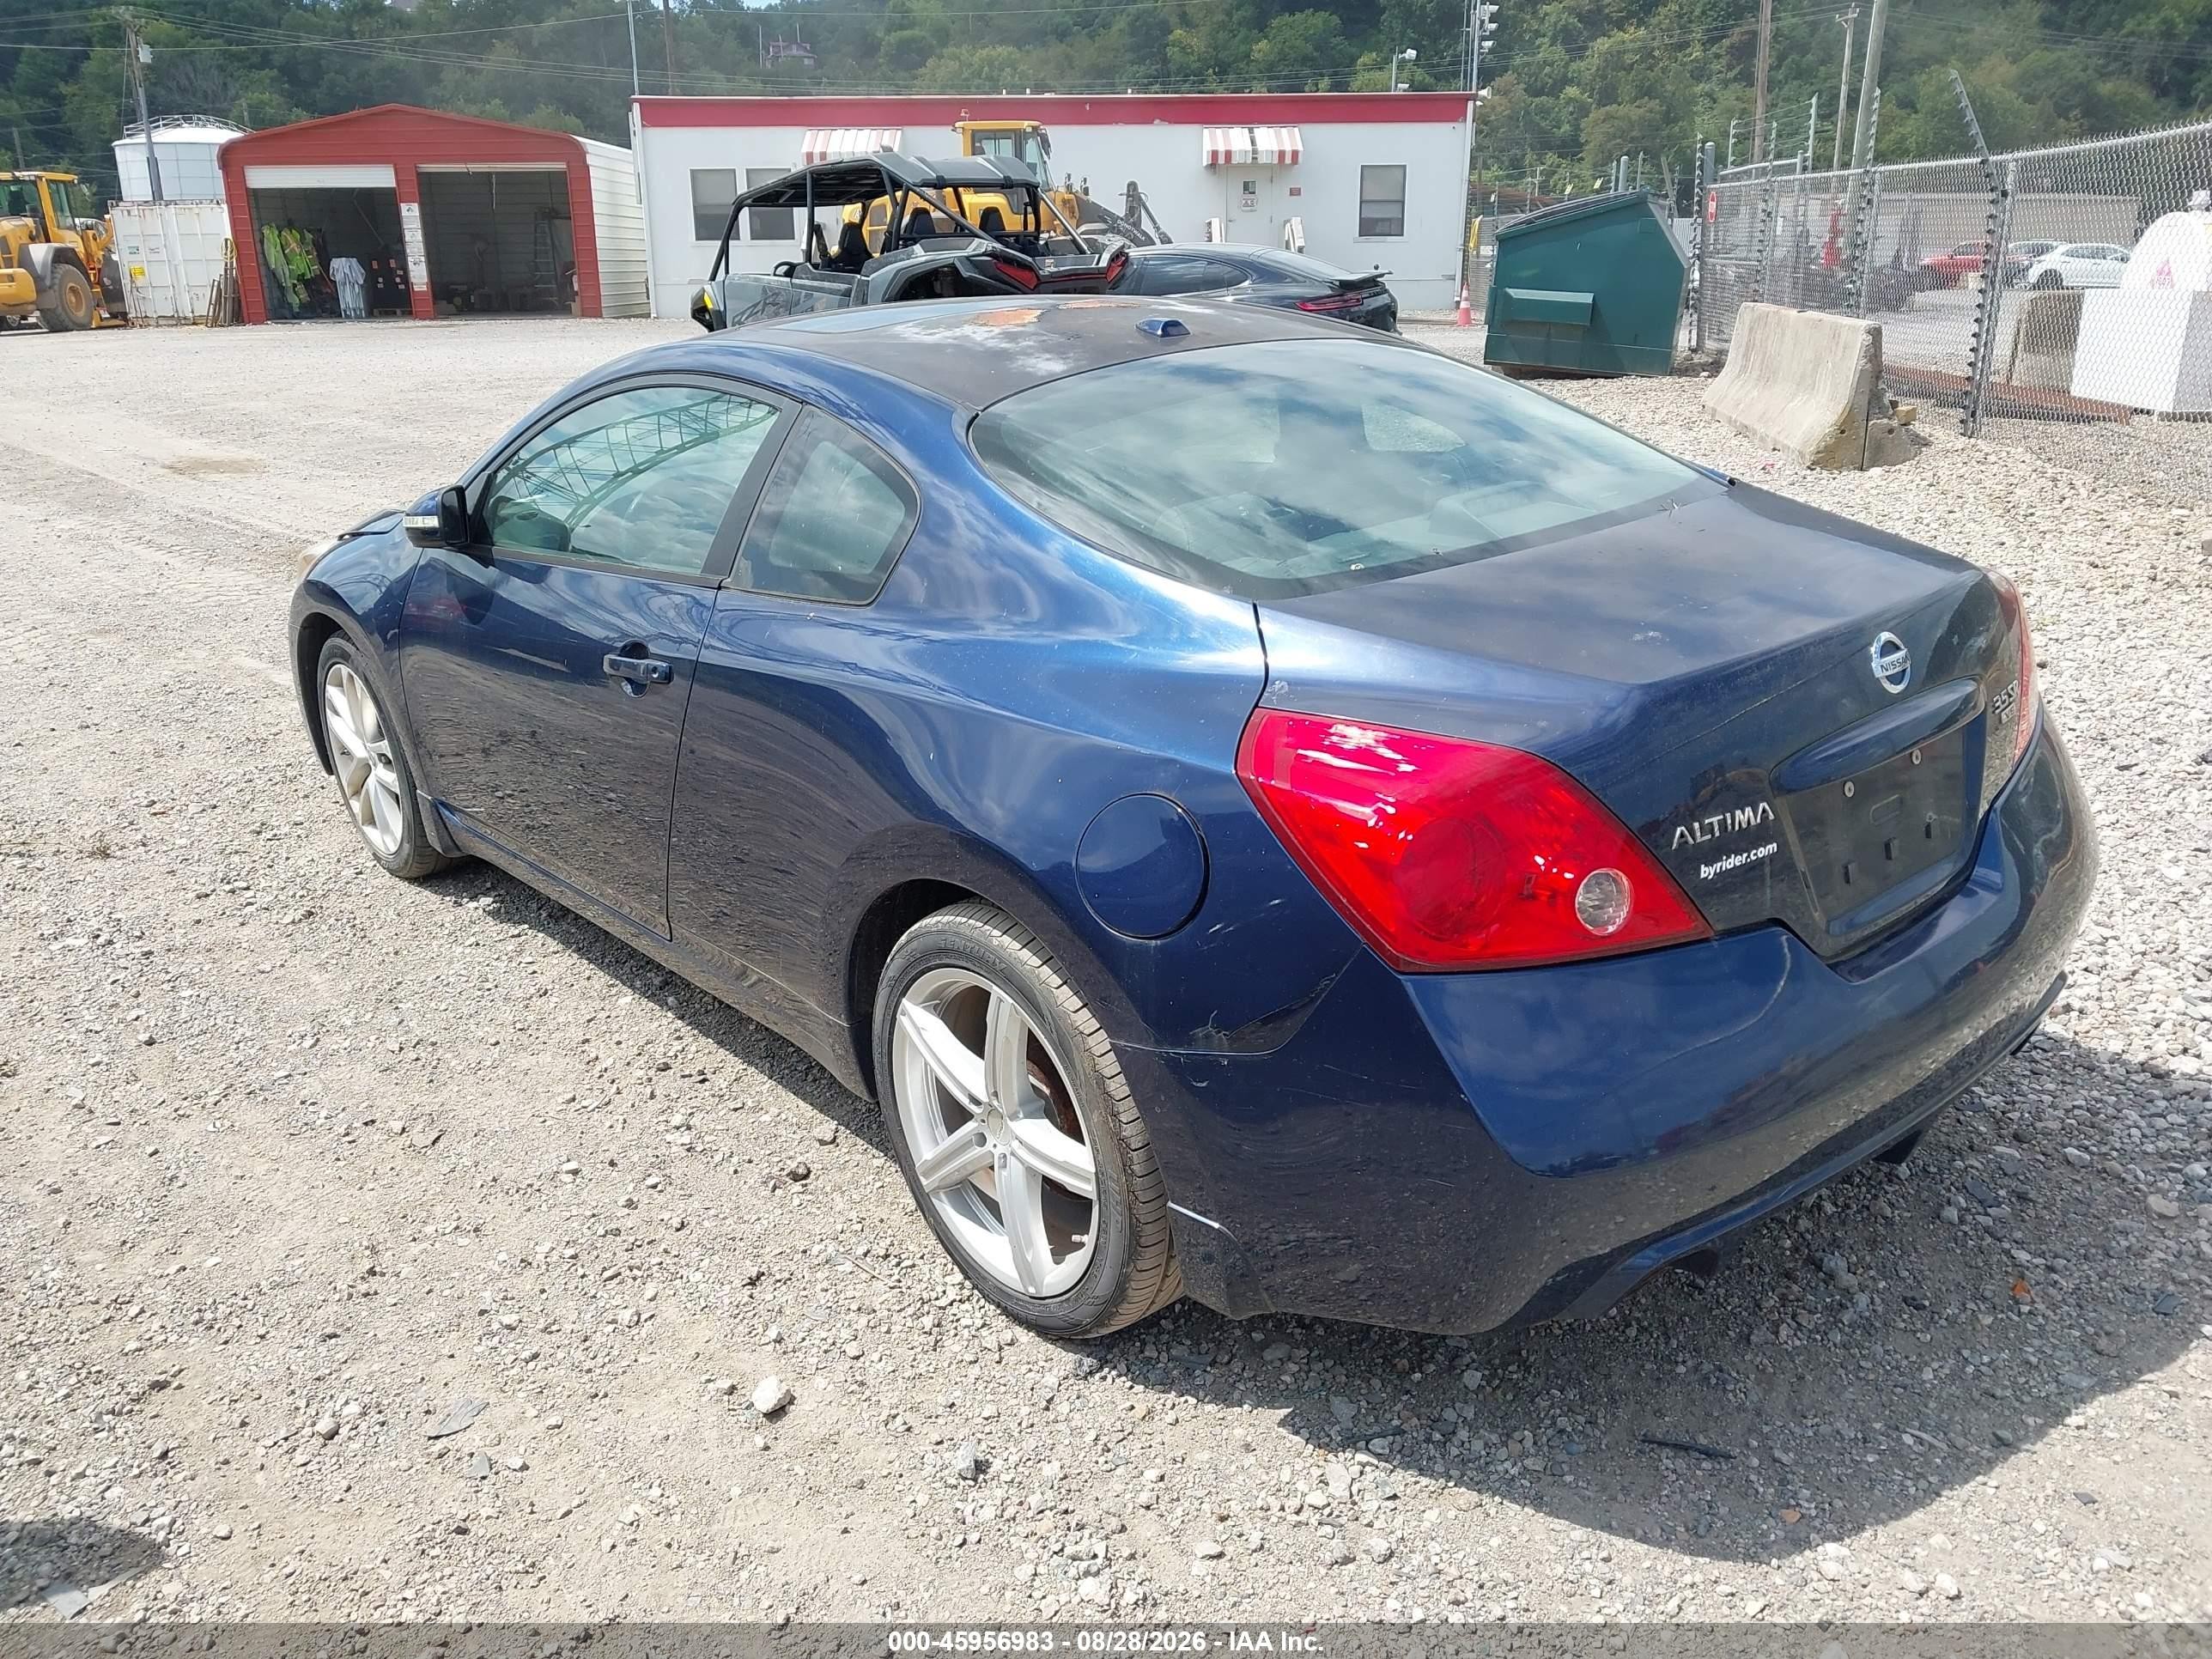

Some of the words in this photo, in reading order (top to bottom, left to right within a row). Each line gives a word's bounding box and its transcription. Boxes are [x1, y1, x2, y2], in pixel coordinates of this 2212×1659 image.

[1881, 653, 1910, 673] NISSAN
[1671, 801, 1775, 851] ALTIMA
[1700, 842, 1778, 879] byrider.com
